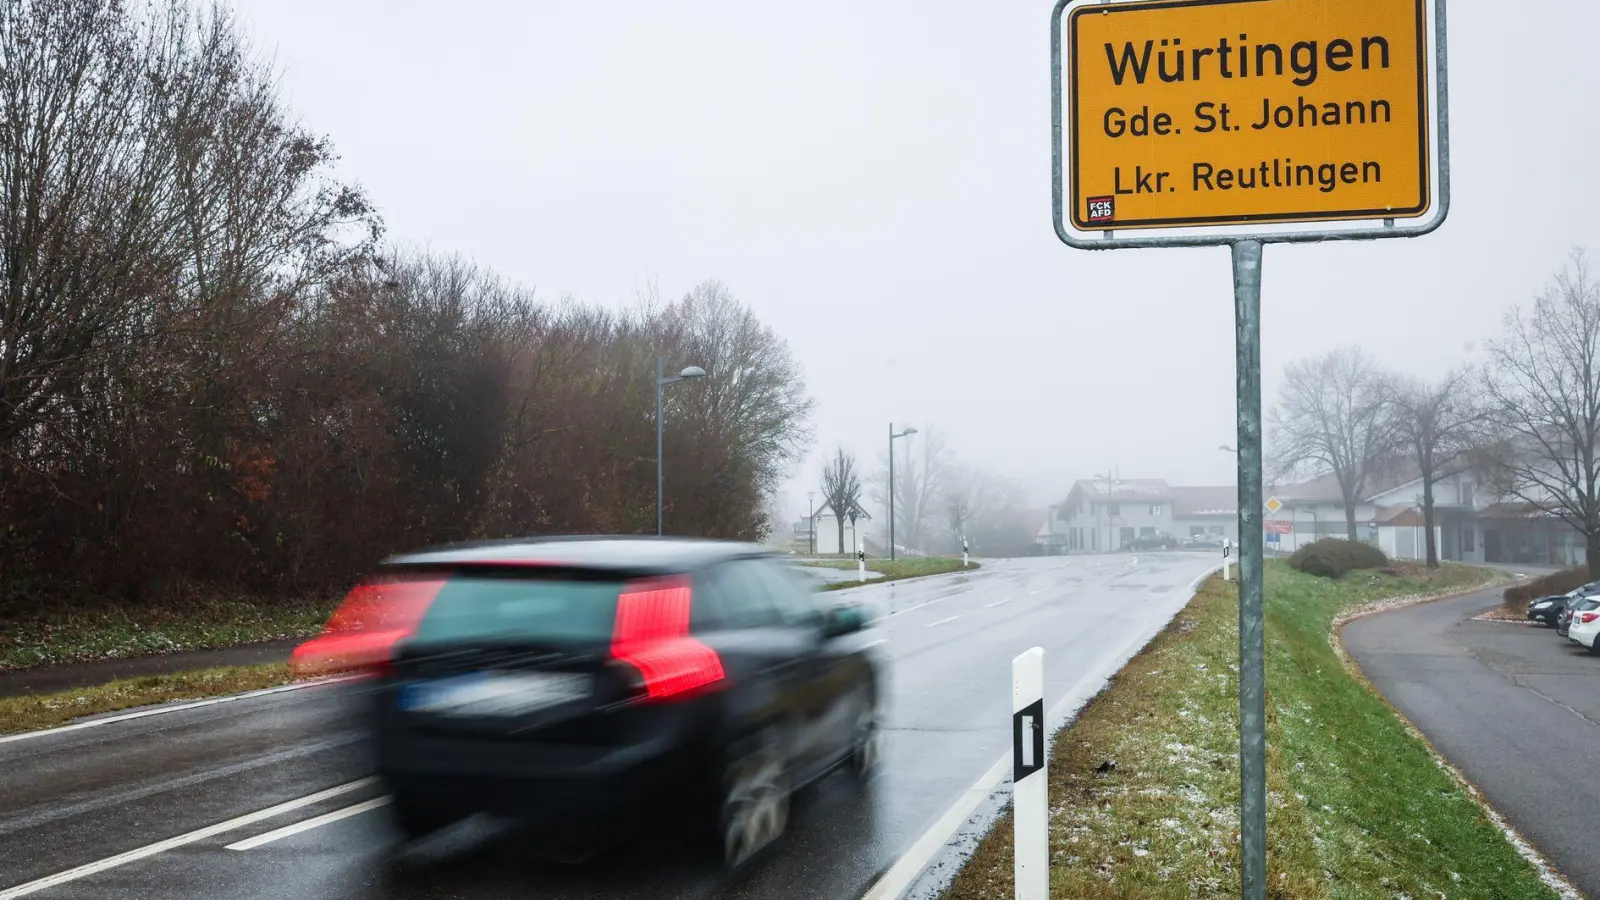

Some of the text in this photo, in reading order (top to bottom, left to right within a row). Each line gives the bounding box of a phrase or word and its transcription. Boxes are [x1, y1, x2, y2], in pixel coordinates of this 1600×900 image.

[1105, 34, 1390, 87] Würtingen
[1103, 96, 1391, 138] Gde. St. Johann
[1114, 158, 1381, 195] Lkr. Reutlingen
[1090, 201, 1111, 210] FCK
[1090, 209, 1111, 217] AFD
